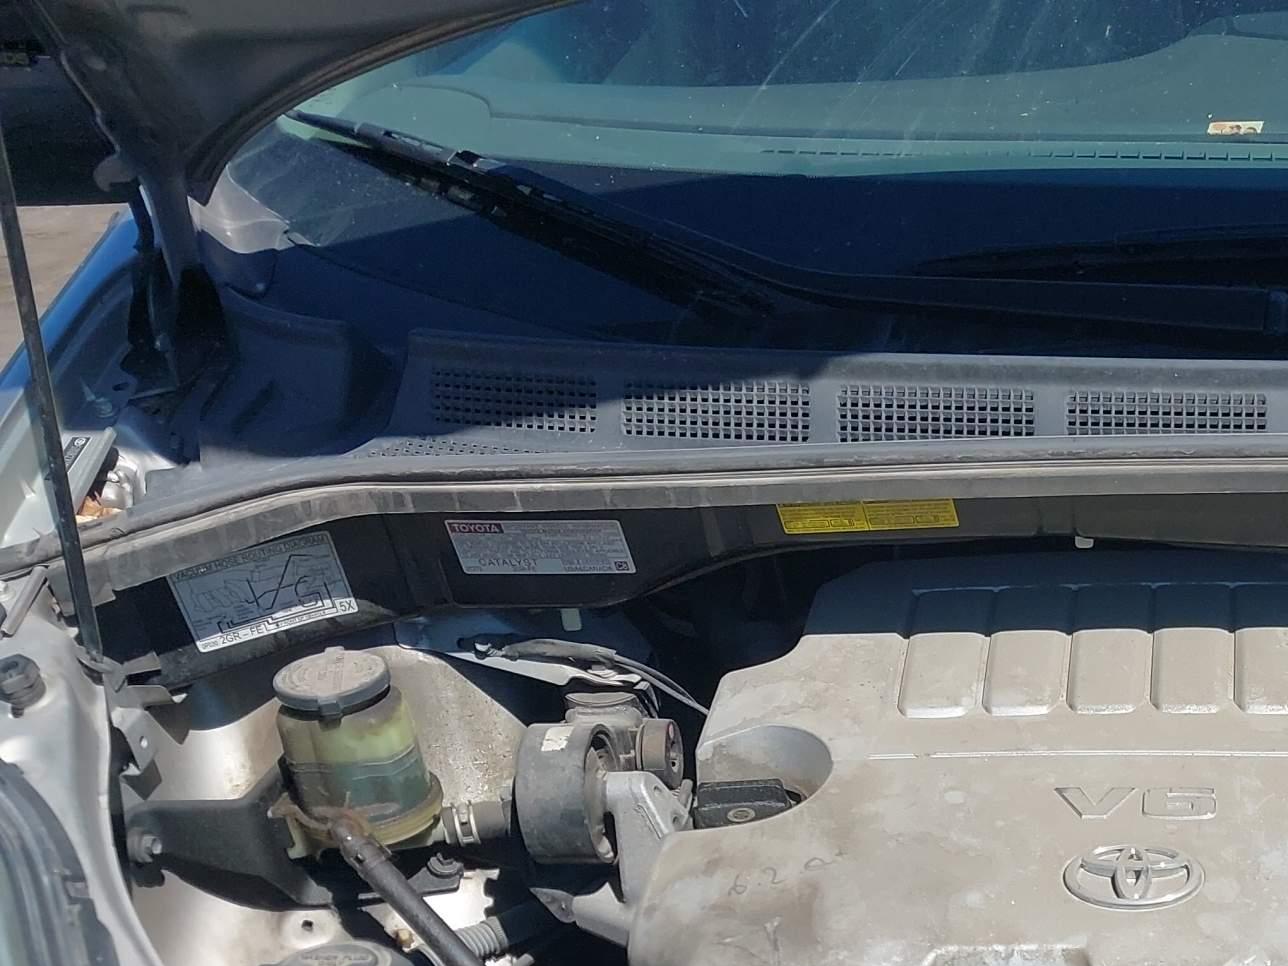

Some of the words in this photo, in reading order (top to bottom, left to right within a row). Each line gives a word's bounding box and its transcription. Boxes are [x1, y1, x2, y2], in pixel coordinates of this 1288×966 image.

[453, 523, 500, 533] TOYOTA
[479, 558, 538, 567] CATALYST
[339, 601, 355, 612] 5X
[1053, 786, 1216, 821] V6
